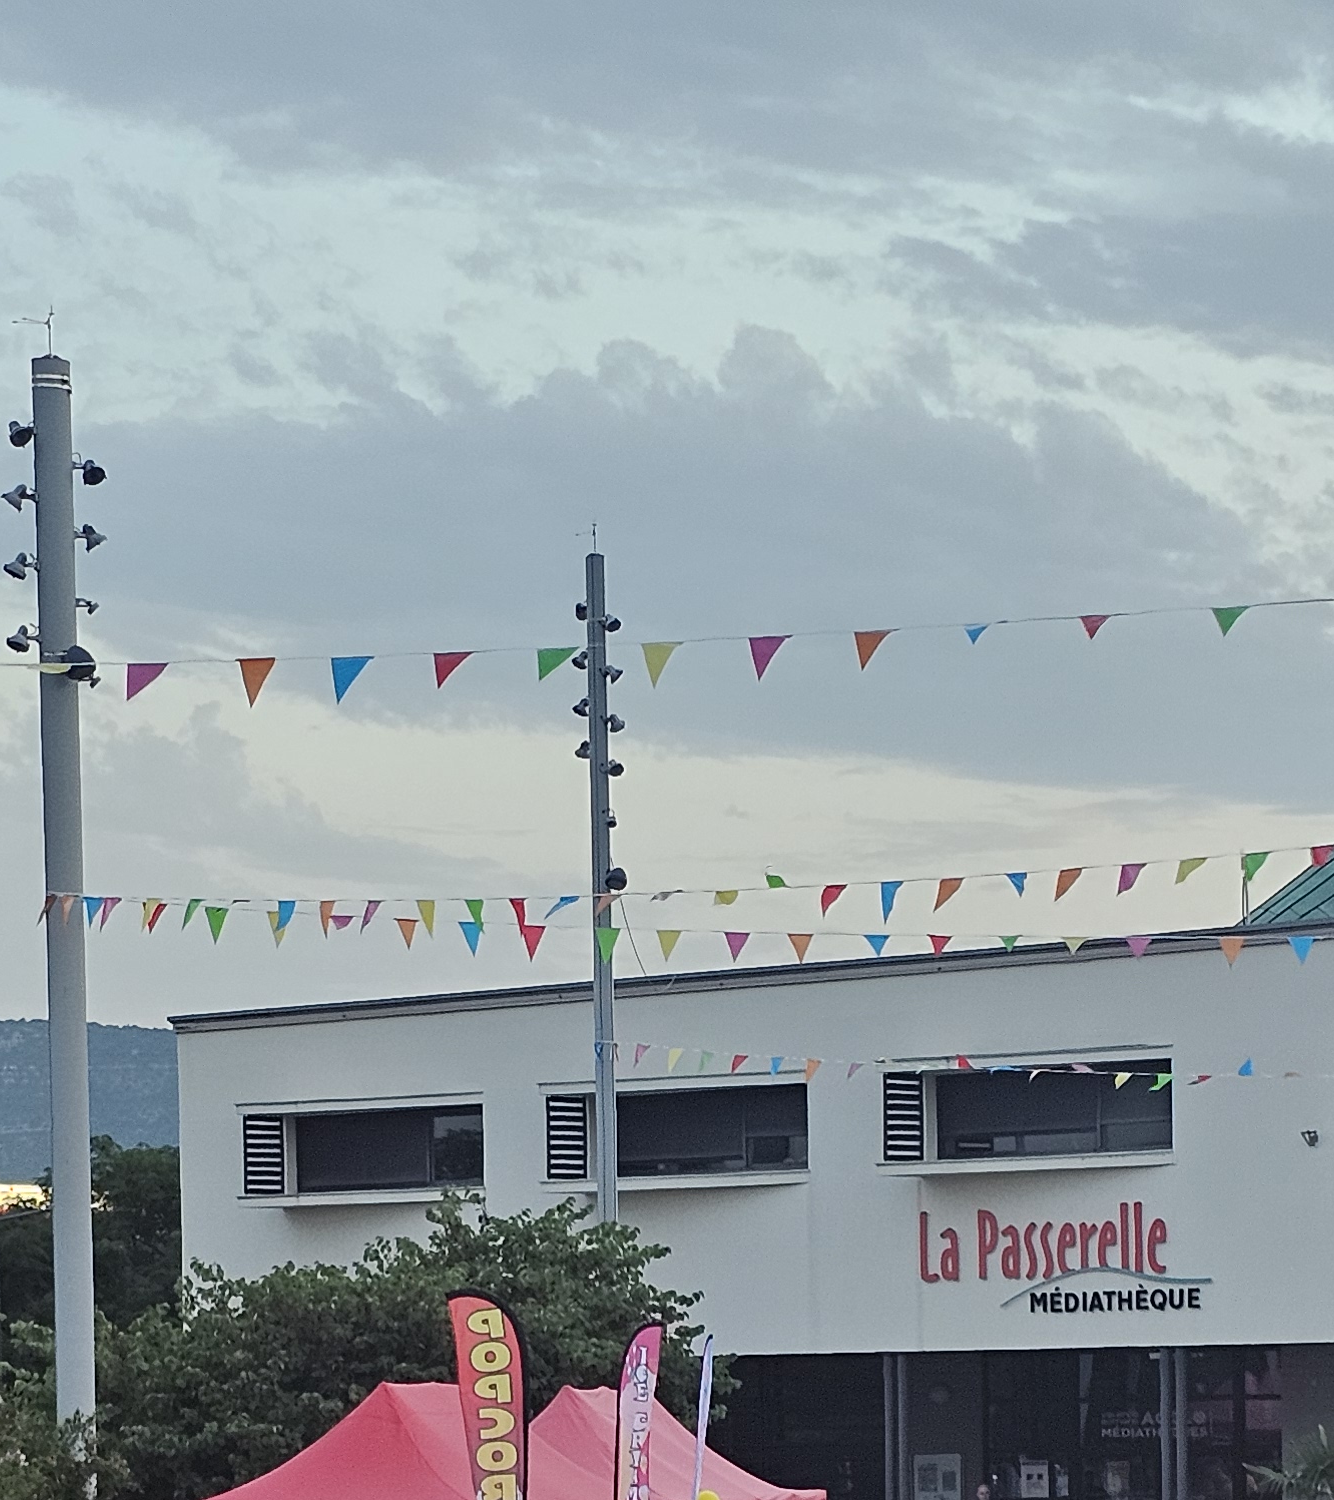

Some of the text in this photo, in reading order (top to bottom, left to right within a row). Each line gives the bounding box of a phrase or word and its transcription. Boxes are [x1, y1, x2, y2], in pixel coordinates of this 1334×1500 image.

[919, 1200, 1168, 1284] La Passerelle
[1029, 1283, 1202, 1314] MÉDIATHÈQUE
